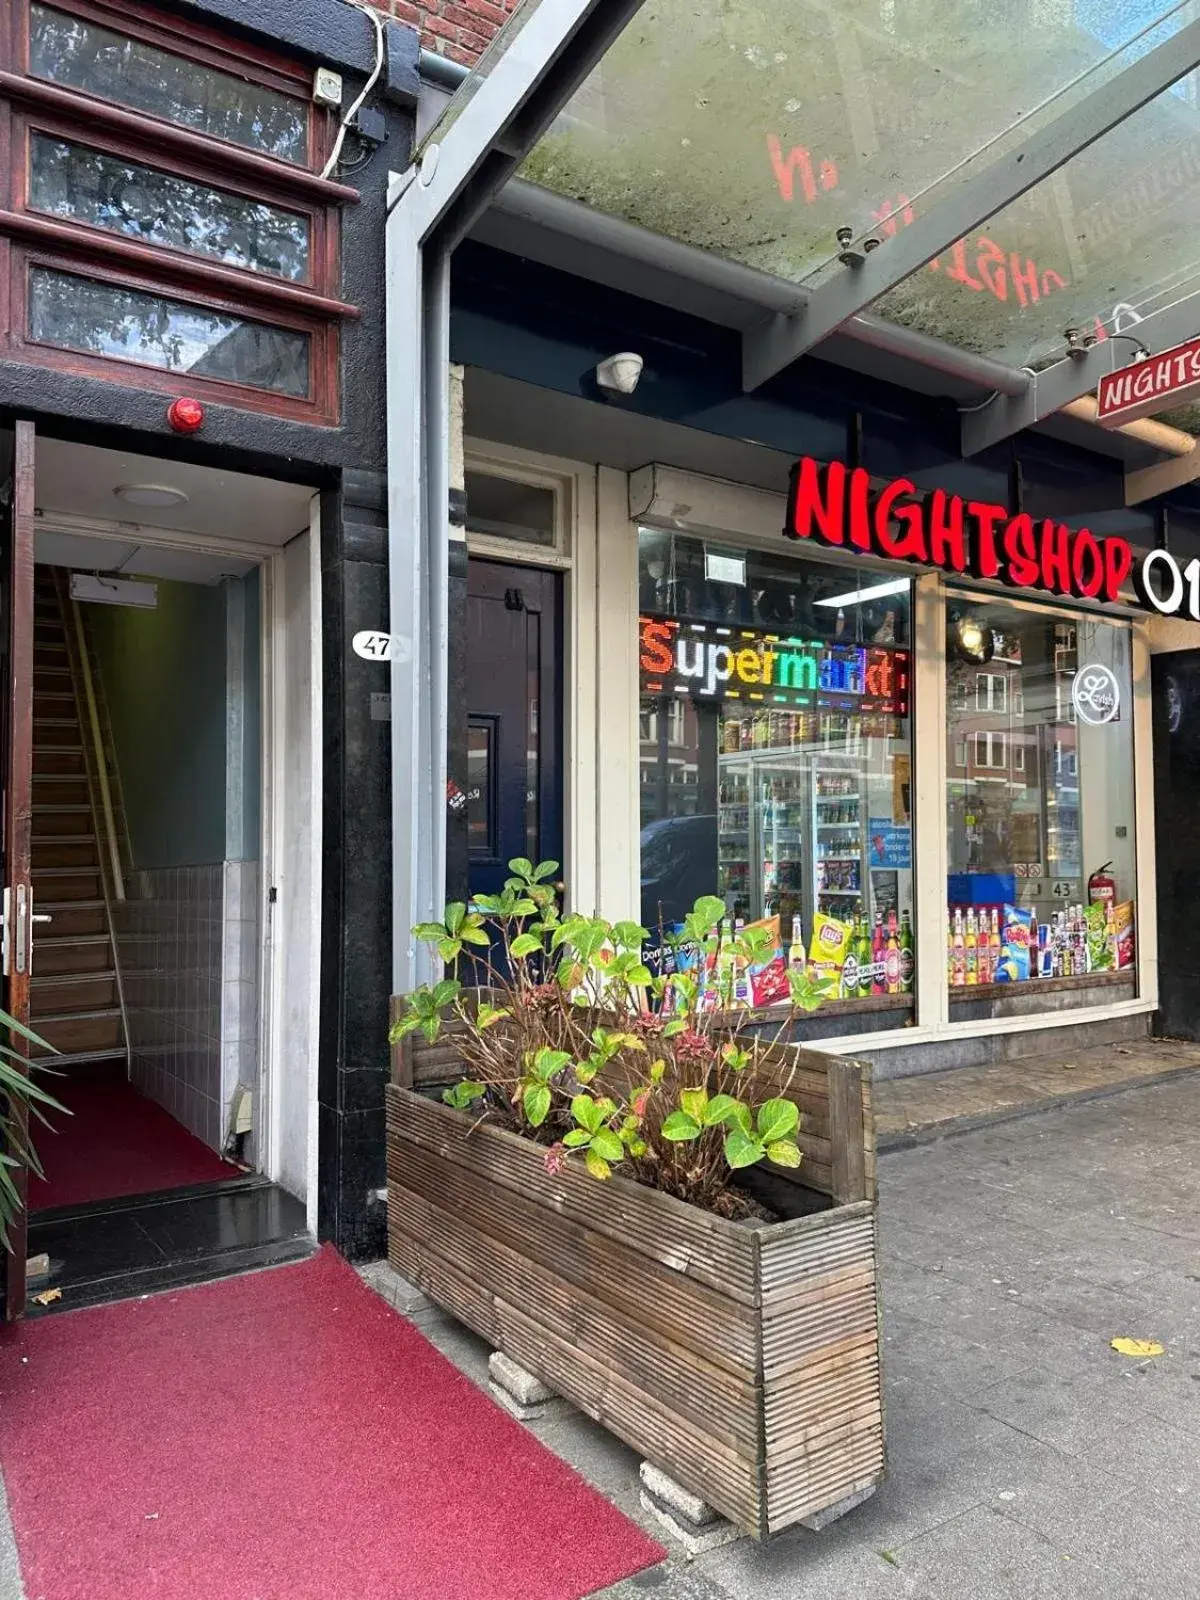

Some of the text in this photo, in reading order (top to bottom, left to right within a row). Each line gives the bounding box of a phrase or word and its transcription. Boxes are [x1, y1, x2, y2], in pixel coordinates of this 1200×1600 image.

[794, 455, 1133, 602] NIGHTSHOP
[640, 620, 893, 697] Supermarkt
[1053, 883, 1071, 897] 43
